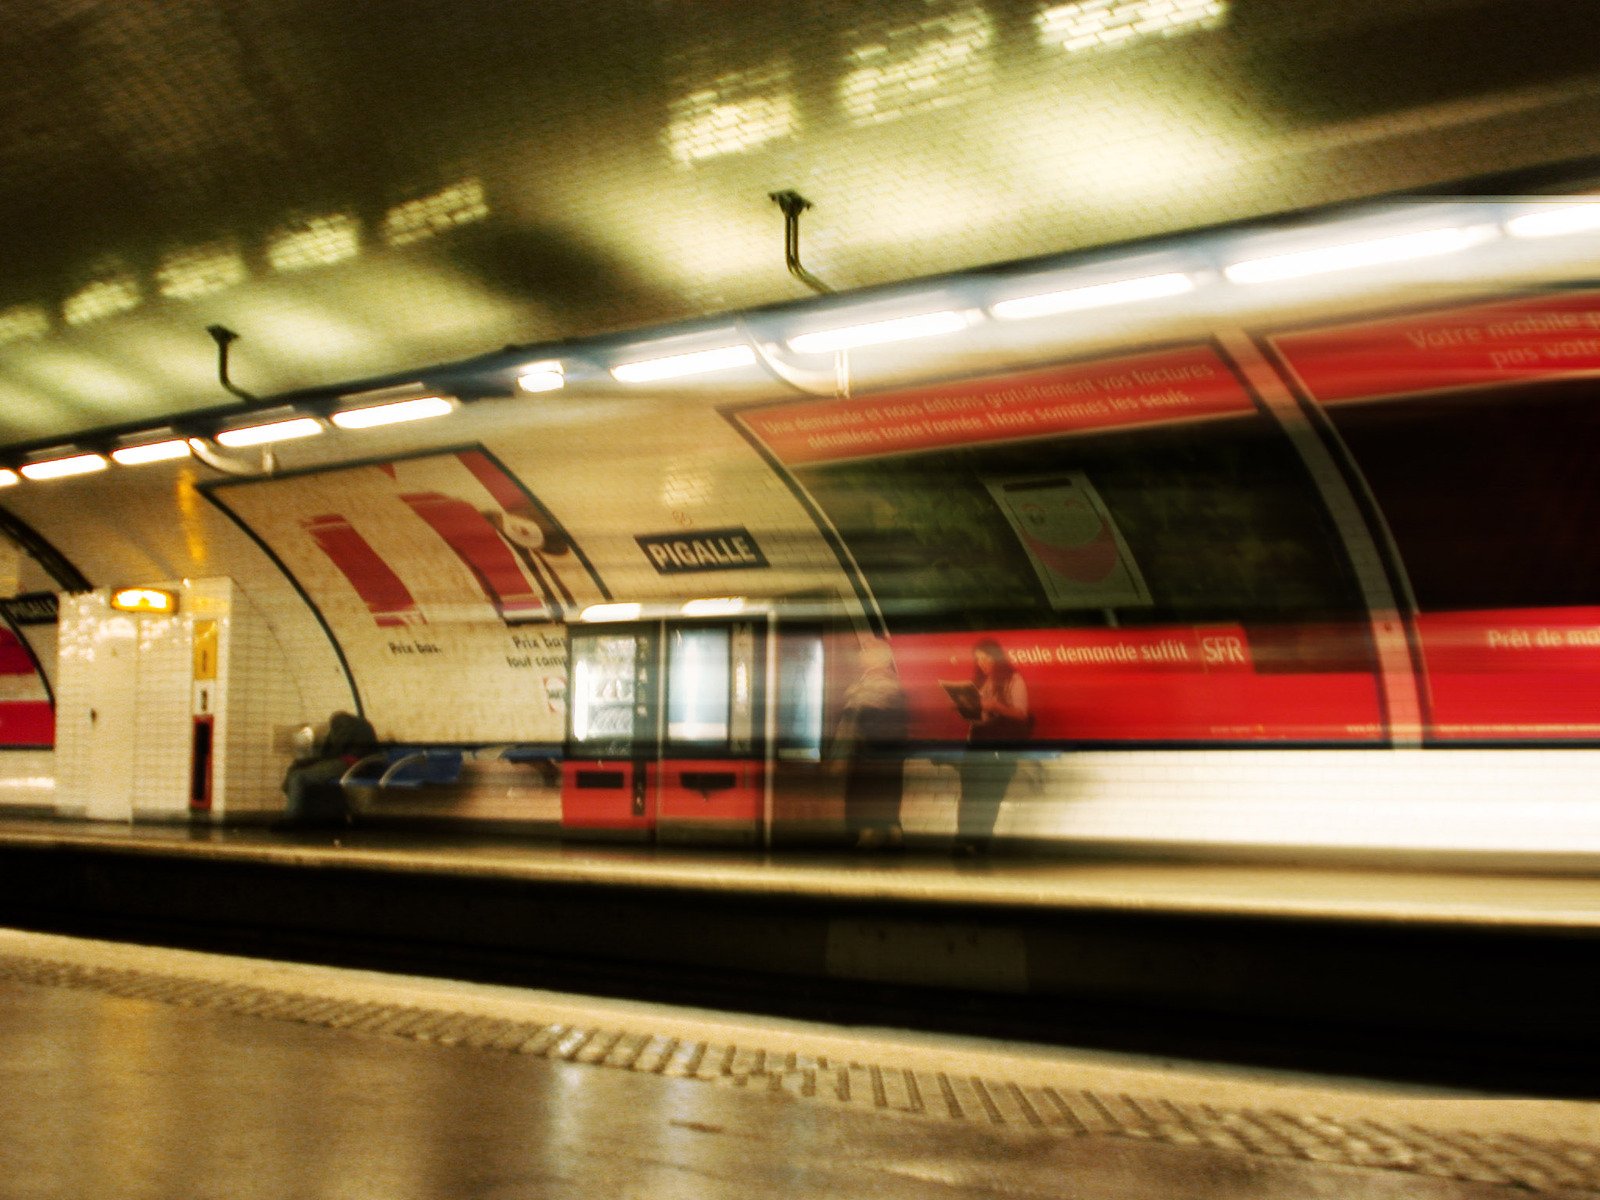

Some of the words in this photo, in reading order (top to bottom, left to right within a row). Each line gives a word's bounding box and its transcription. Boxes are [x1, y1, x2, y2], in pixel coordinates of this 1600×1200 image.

[1406, 327, 1482, 348] Votre
[1487, 313, 1578, 338] mobile
[1488, 347, 1539, 370] pas
[884, 405, 924, 420] nous
[985, 379, 1098, 408] gratuitement
[1098, 376, 1132, 391] vos
[1132, 363, 1214, 384] factures
[986, 410, 1035, 428] Nous
[1036, 400, 1109, 419] sommes
[1109, 396, 1139, 411] les
[646, 535, 757, 567] PIGALLE
[1008, 644, 1051, 664] seule
[1056, 641, 1137, 664] demande
[1140, 639, 1188, 661] suffit
[1200, 636, 1246, 664] SFR
[1535, 628, 1562, 647] de
